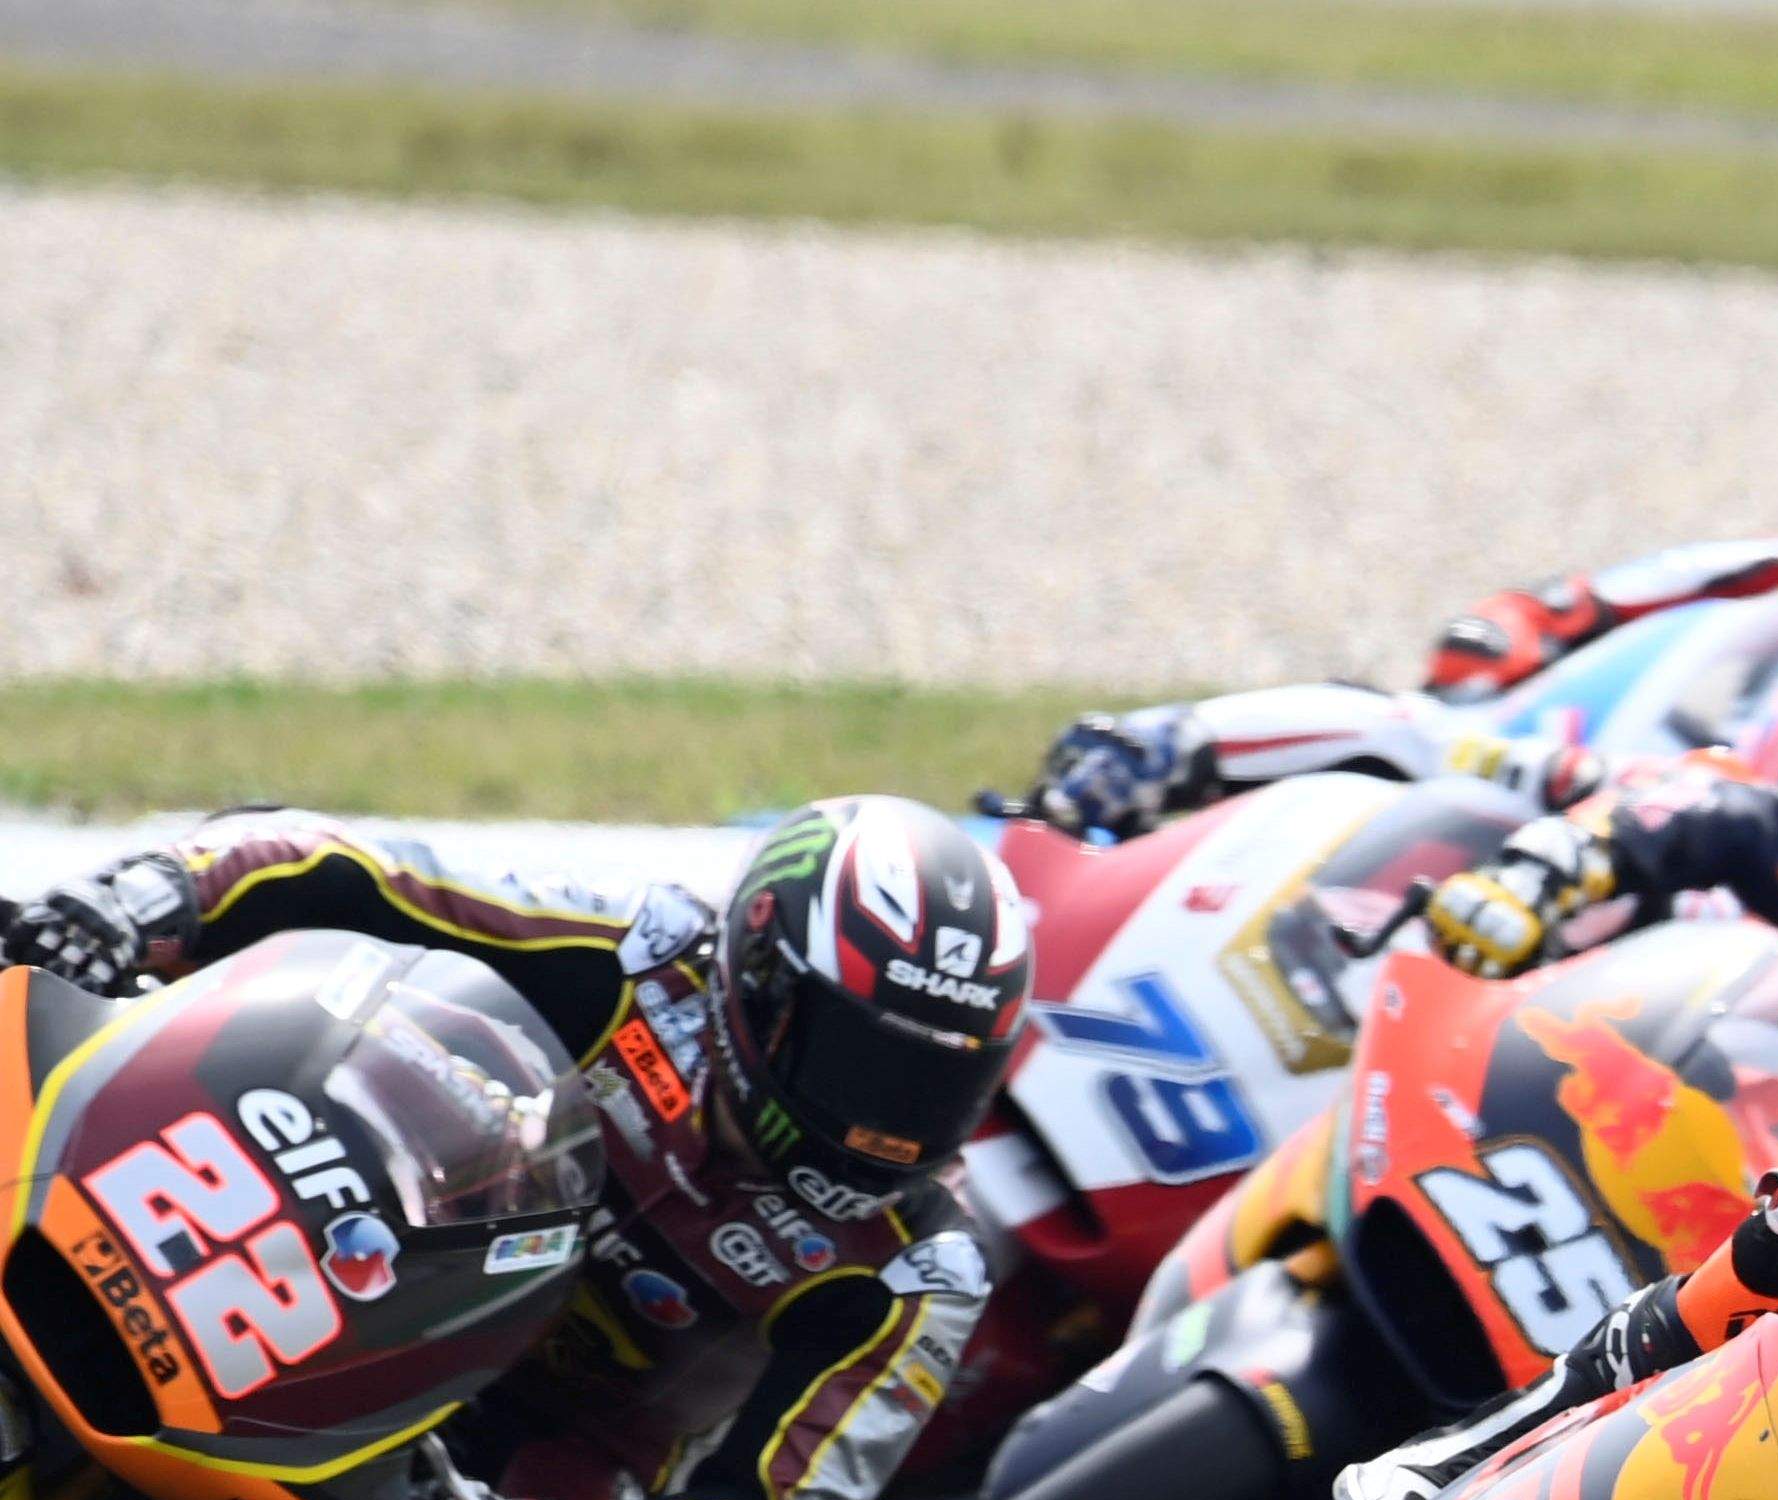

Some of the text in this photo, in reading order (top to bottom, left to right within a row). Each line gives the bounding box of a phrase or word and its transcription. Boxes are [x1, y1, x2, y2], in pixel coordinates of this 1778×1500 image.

[885, 958, 1000, 1010] SHARK
[236, 1087, 373, 1210] elf
[80, 1110, 344, 1400] 22
[1412, 1142, 1638, 1358] 25
[98, 1268, 181, 1386] Beta
